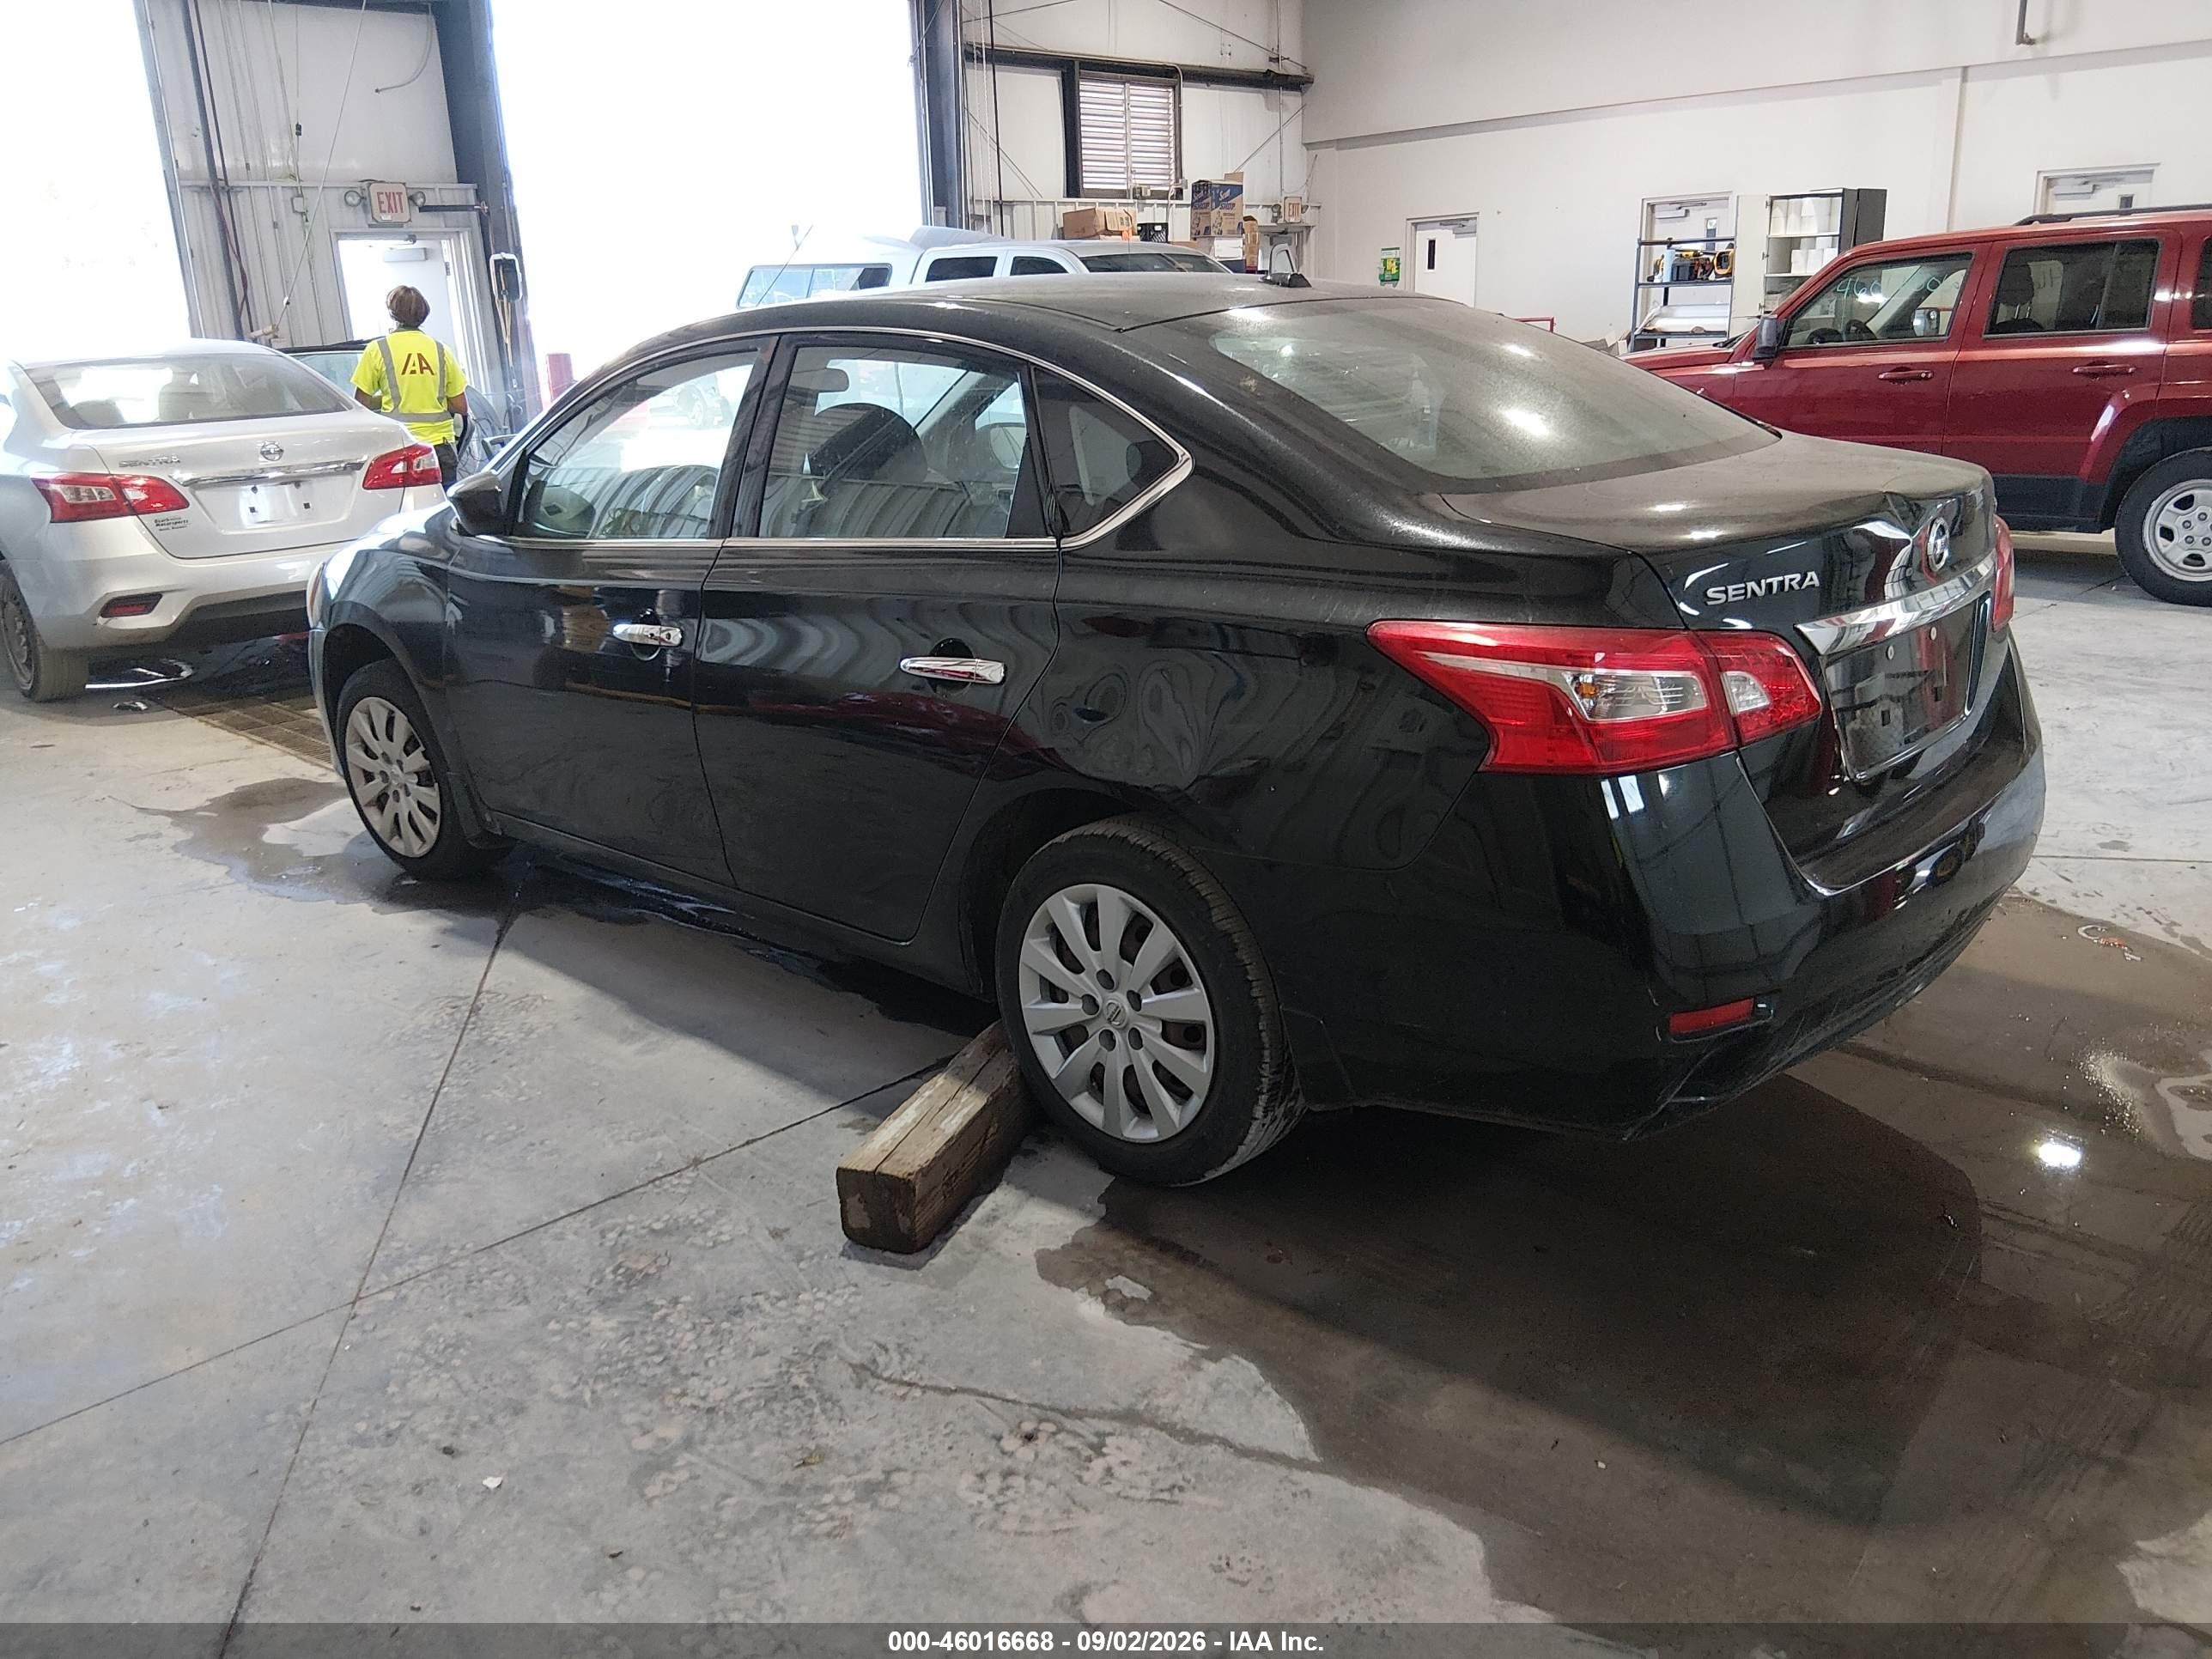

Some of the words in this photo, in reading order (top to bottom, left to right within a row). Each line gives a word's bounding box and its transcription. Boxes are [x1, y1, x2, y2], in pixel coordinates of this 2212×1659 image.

[376, 191, 404, 214] EXIT
[118, 454, 181, 468] SENTRA
[1705, 571, 1820, 605] SENTRA
